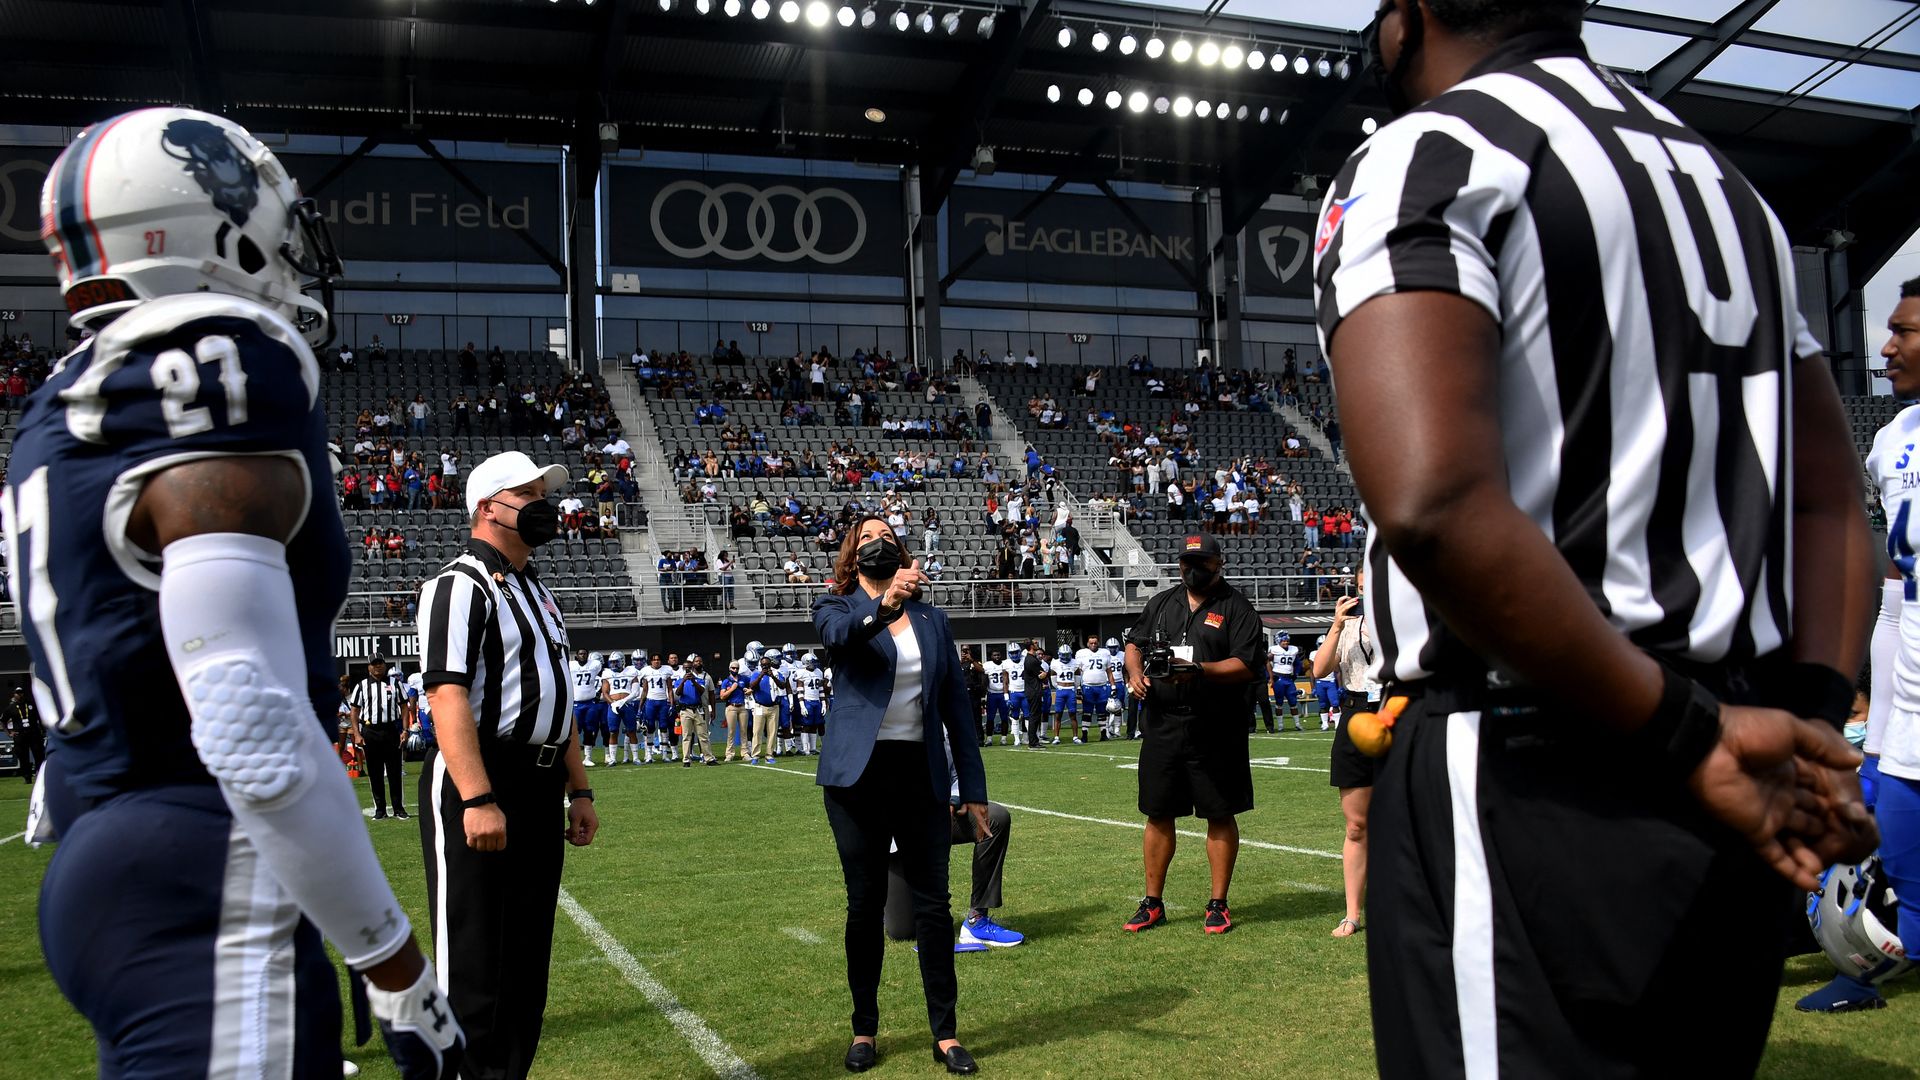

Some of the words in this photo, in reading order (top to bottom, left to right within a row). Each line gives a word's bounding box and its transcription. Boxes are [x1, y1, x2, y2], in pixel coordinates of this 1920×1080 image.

[316, 192, 390, 225] udi
[410, 193, 530, 229] Field
[144, 230, 166, 256] 27
[1007, 221, 1194, 260] EAGLEBANK
[1613, 127, 1758, 347] U
[0, 311, 16, 320] 26
[391, 314, 409, 324] 127
[752, 322, 768, 332] 128
[1073, 334, 1087, 343] 129
[150, 335, 249, 440] 27
[389, 635, 421, 656] THE
[1088, 659, 1103, 670] 75
[1280, 656, 1293, 666] 96
[576, 673, 591, 686] 77
[613, 679, 629, 690] 97
[650, 677, 664, 689] 14
